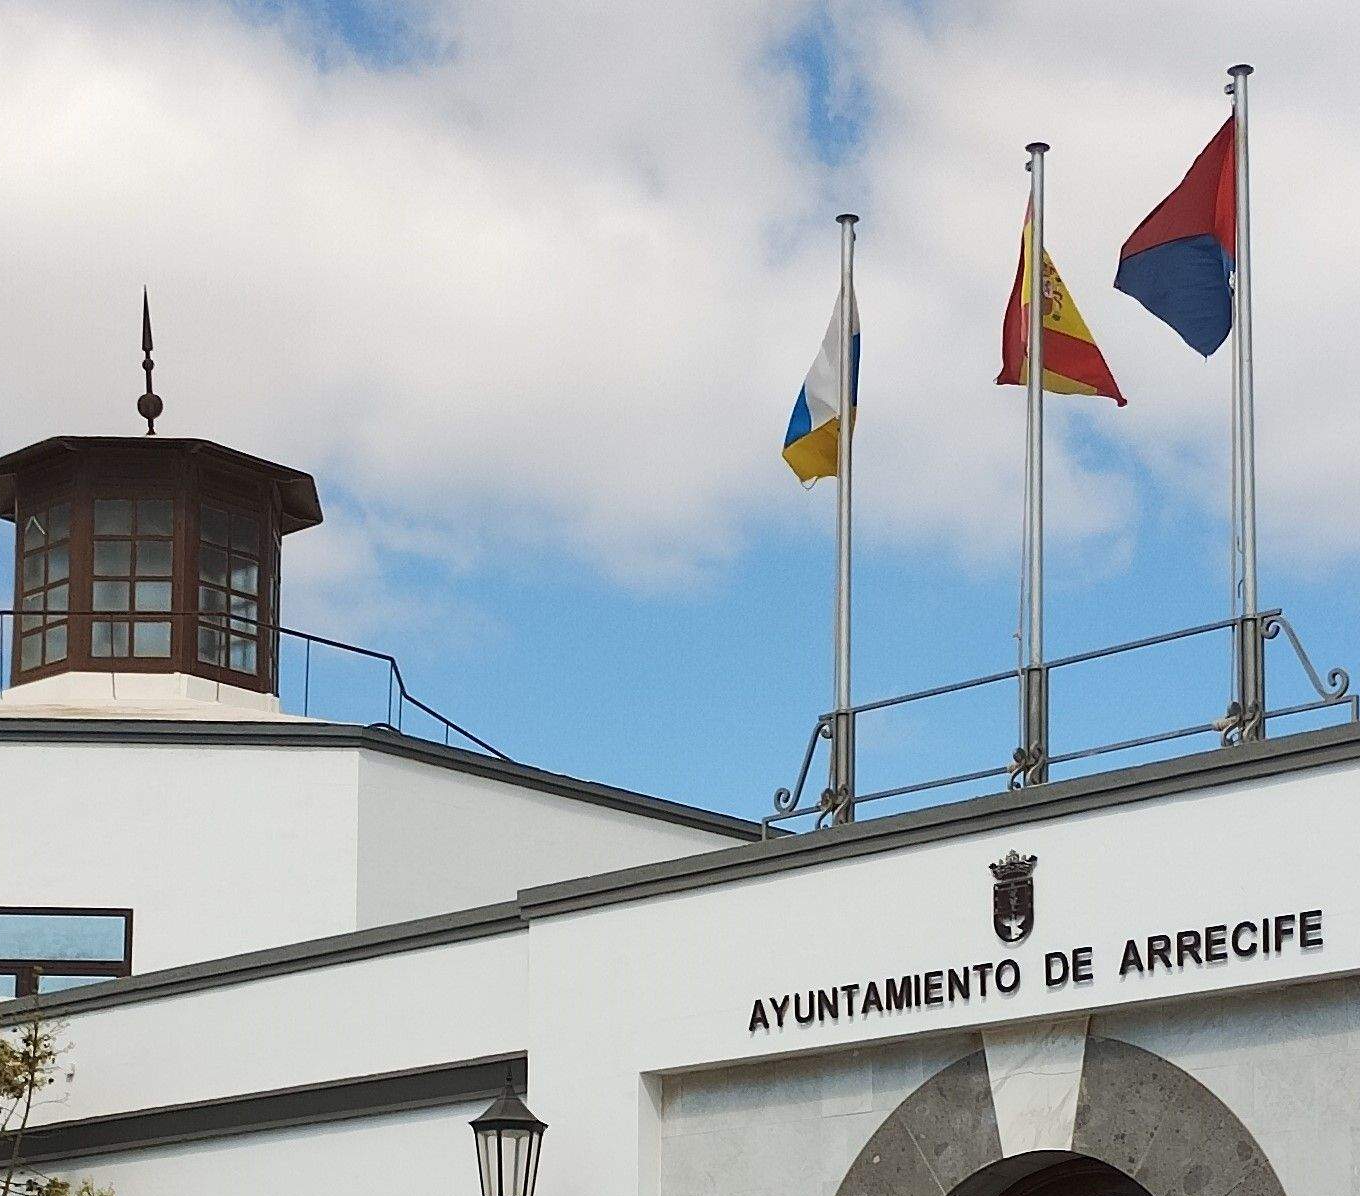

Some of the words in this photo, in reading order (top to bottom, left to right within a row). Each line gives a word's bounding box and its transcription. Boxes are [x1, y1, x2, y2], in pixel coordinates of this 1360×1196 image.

[748, 957, 1021, 1032] AYUNTAMIENTO
[1044, 946, 1094, 987] DE
[1119, 909, 1324, 977] ARRECIFE
